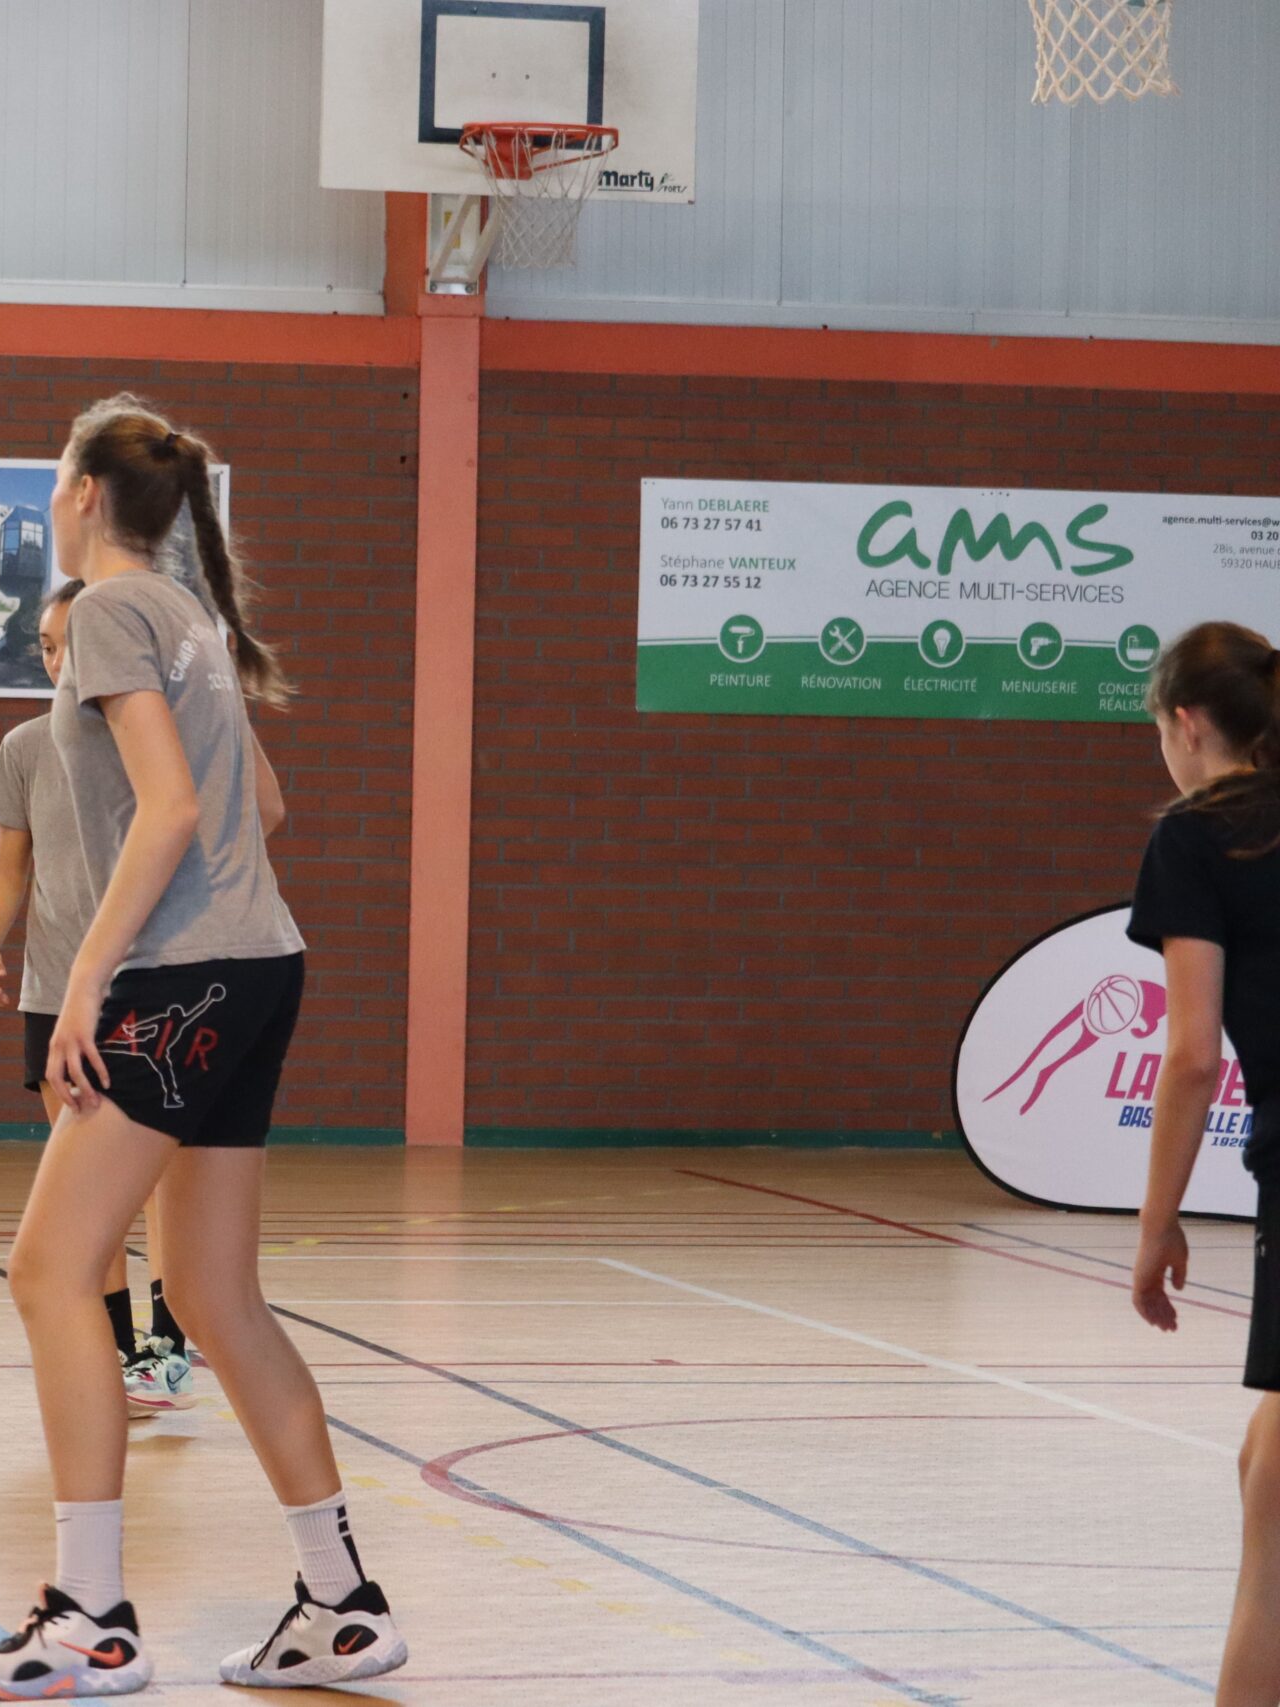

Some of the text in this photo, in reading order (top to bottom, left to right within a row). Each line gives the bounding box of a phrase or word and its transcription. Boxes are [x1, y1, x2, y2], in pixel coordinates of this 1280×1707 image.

[598, 170, 654, 192] Marty
[660, 497, 770, 513] Yann DEBLAERE
[660, 516, 762, 532] 06 73 27 57 41
[1250, 530, 1279, 541] 03 20
[1239, 546, 1275, 555] avenue
[660, 554, 797, 571] Stéphane VANTEUX
[1221, 558, 1252, 569] 59320
[659, 574, 762, 589] 06 73 27 55 12
[866, 579, 1124, 604] AGENCE MULTI-SERVICES
[709, 673, 771, 688] PEINTURE
[801, 674, 882, 690] RÉNOVATION
[903, 676, 977, 692] ÉLECTRICITÉ
[1001, 680, 1078, 694] MENUISERIE
[1098, 681, 1150, 696] CONCEP
[1099, 697, 1148, 712] RÉALISA
